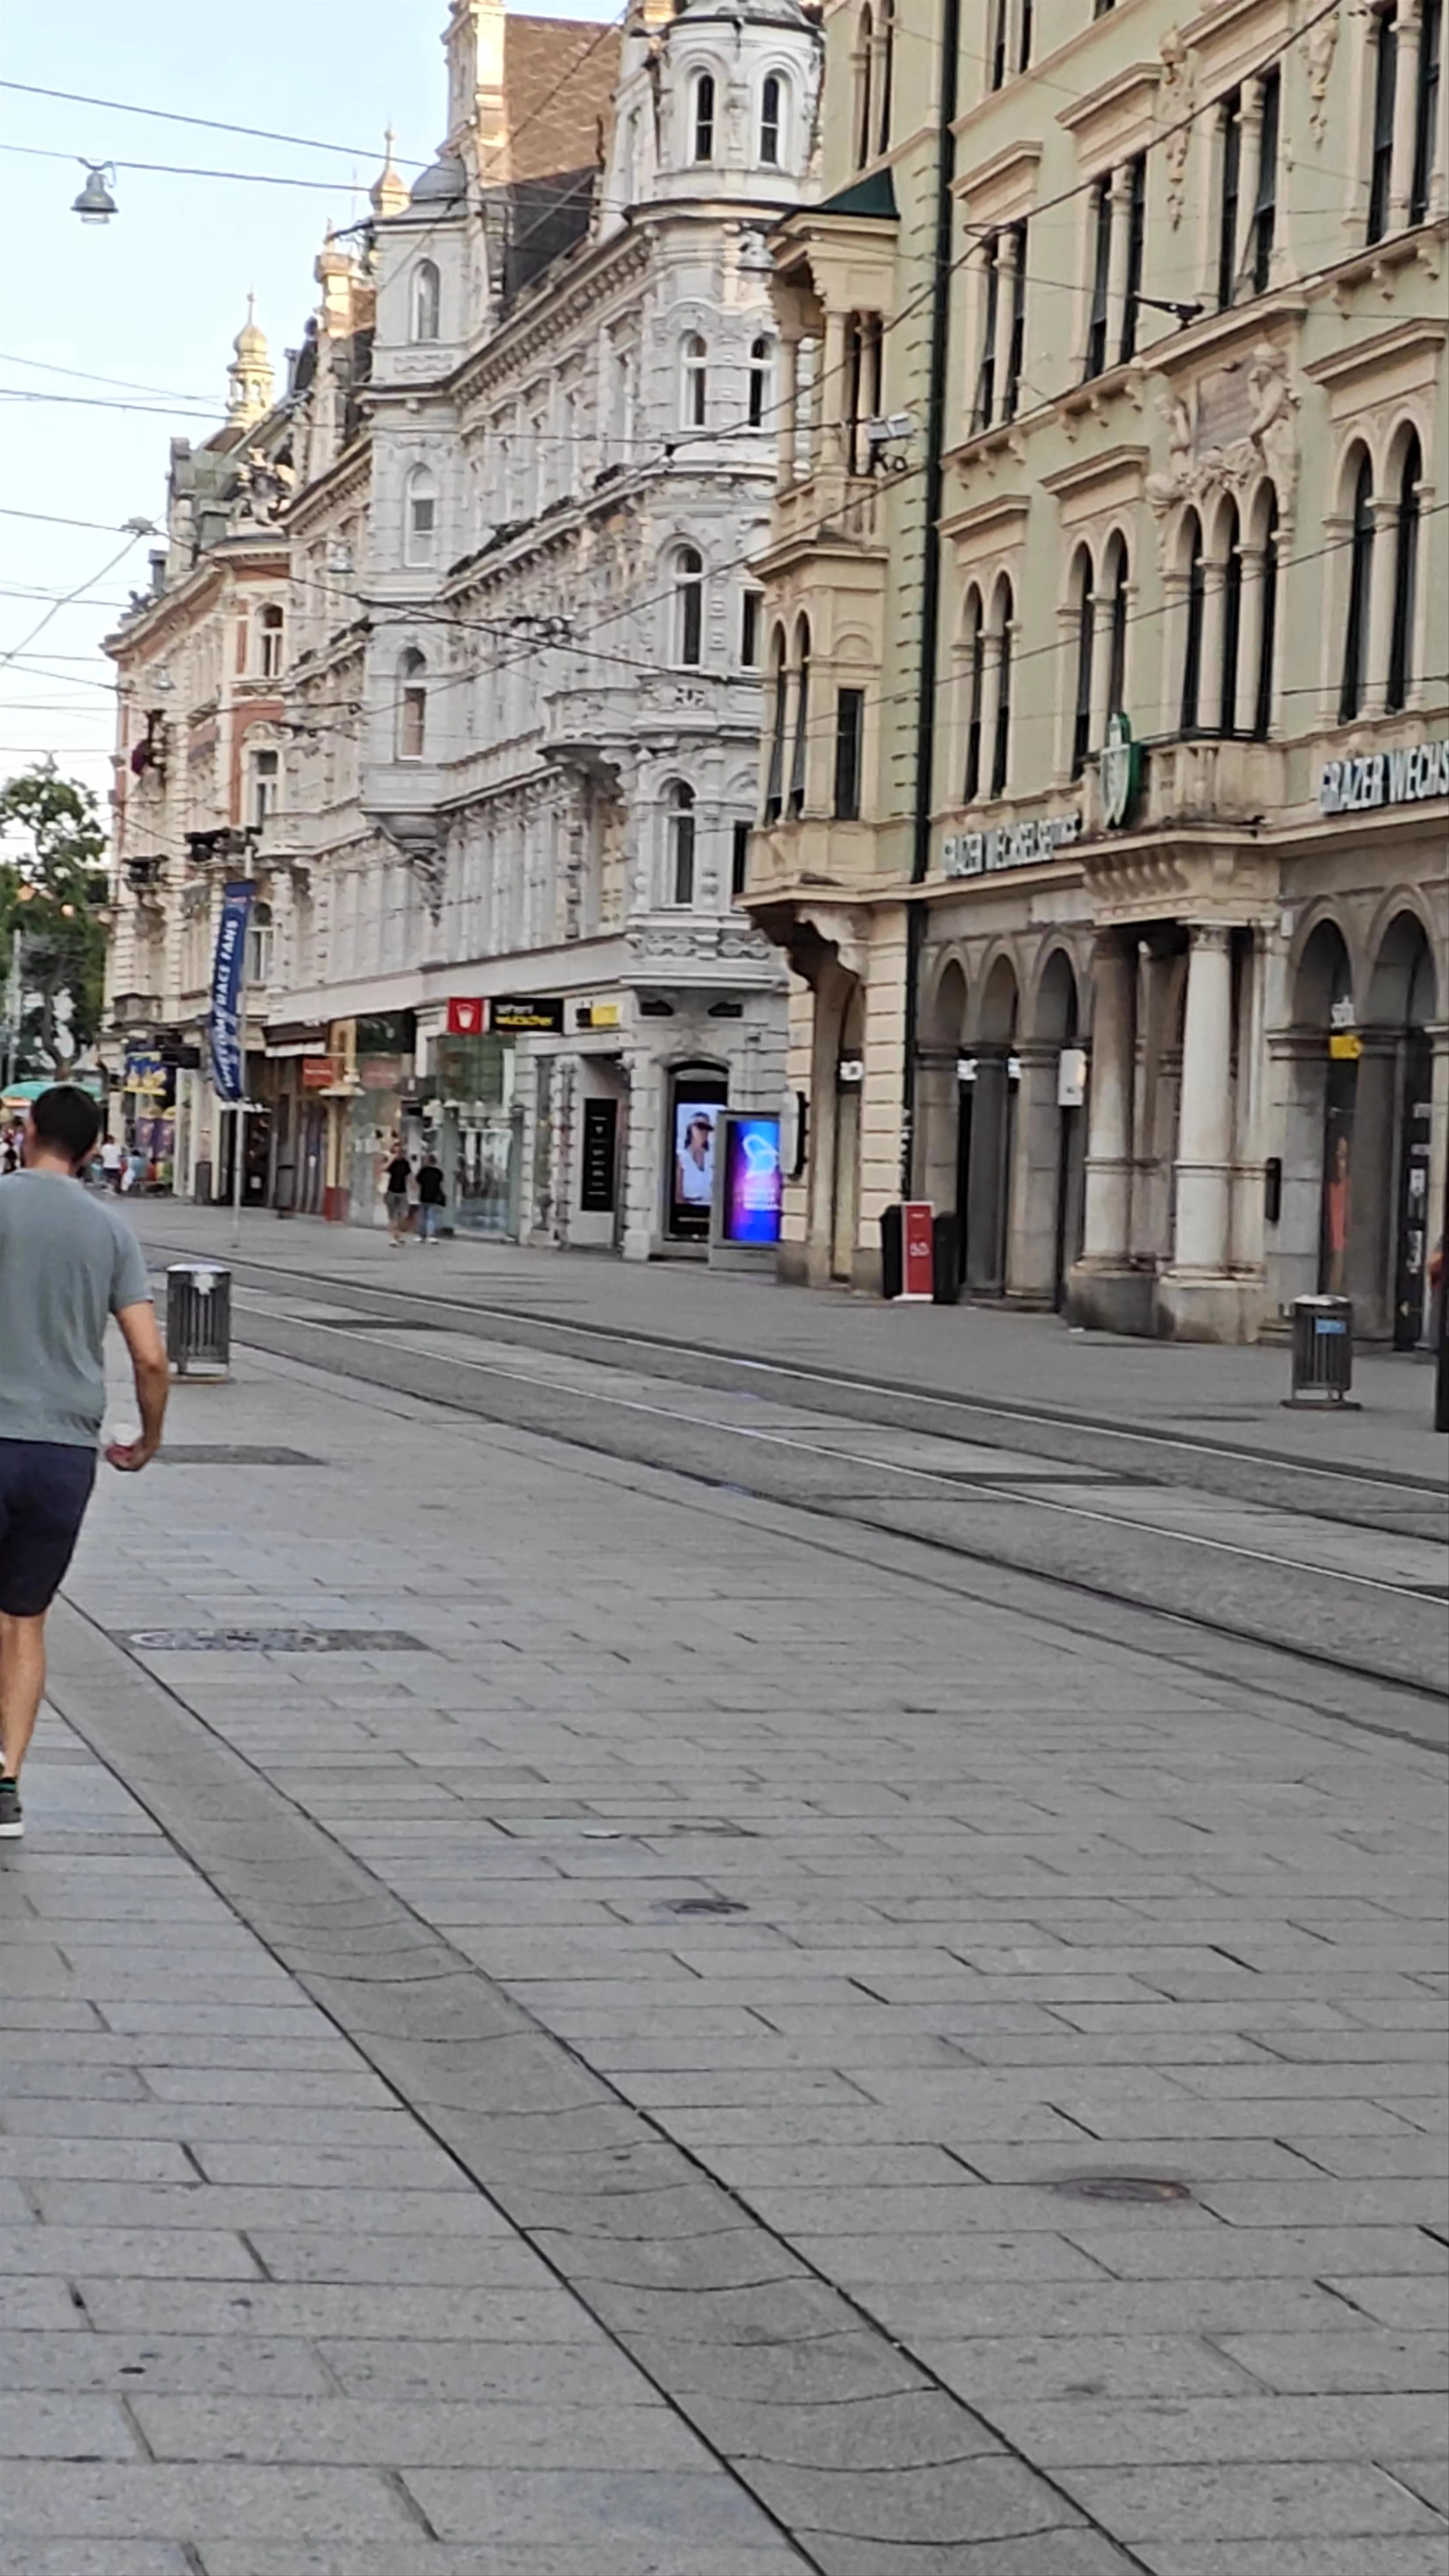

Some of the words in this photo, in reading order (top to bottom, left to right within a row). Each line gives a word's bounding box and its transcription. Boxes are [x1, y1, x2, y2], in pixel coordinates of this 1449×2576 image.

[1320, 756, 1384, 812] GRAZER
[942, 833, 983, 876] GRAZER
[220, 920, 238, 960] FANS
[216, 964, 231, 1005] RACE
